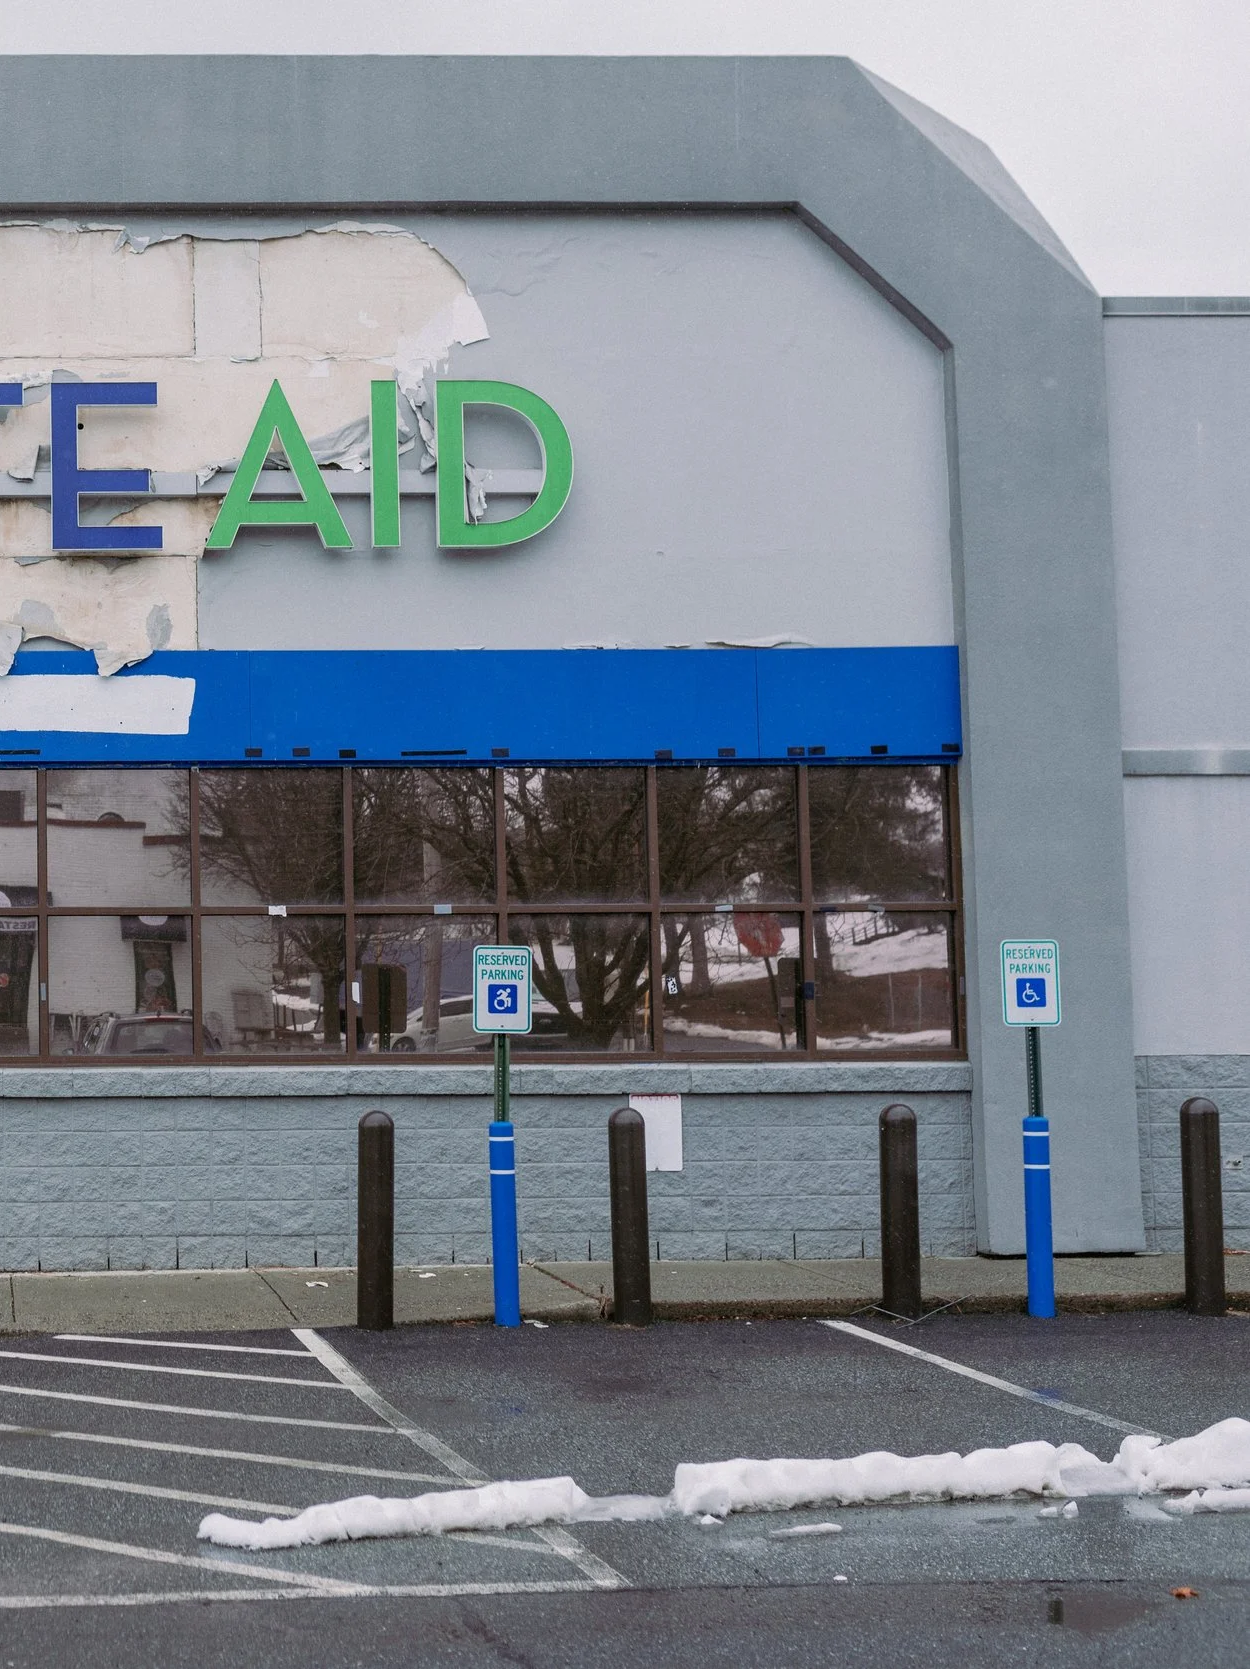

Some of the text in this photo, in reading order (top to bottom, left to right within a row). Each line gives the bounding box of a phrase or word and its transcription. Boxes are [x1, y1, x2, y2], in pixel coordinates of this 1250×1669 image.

[205, 379, 573, 549] AID
[478, 954, 527, 966] RESERVED
[1006, 949, 1053, 960] RESERVED
[1010, 963, 1051, 974] PARKING
[481, 969, 524, 980] PARKING
